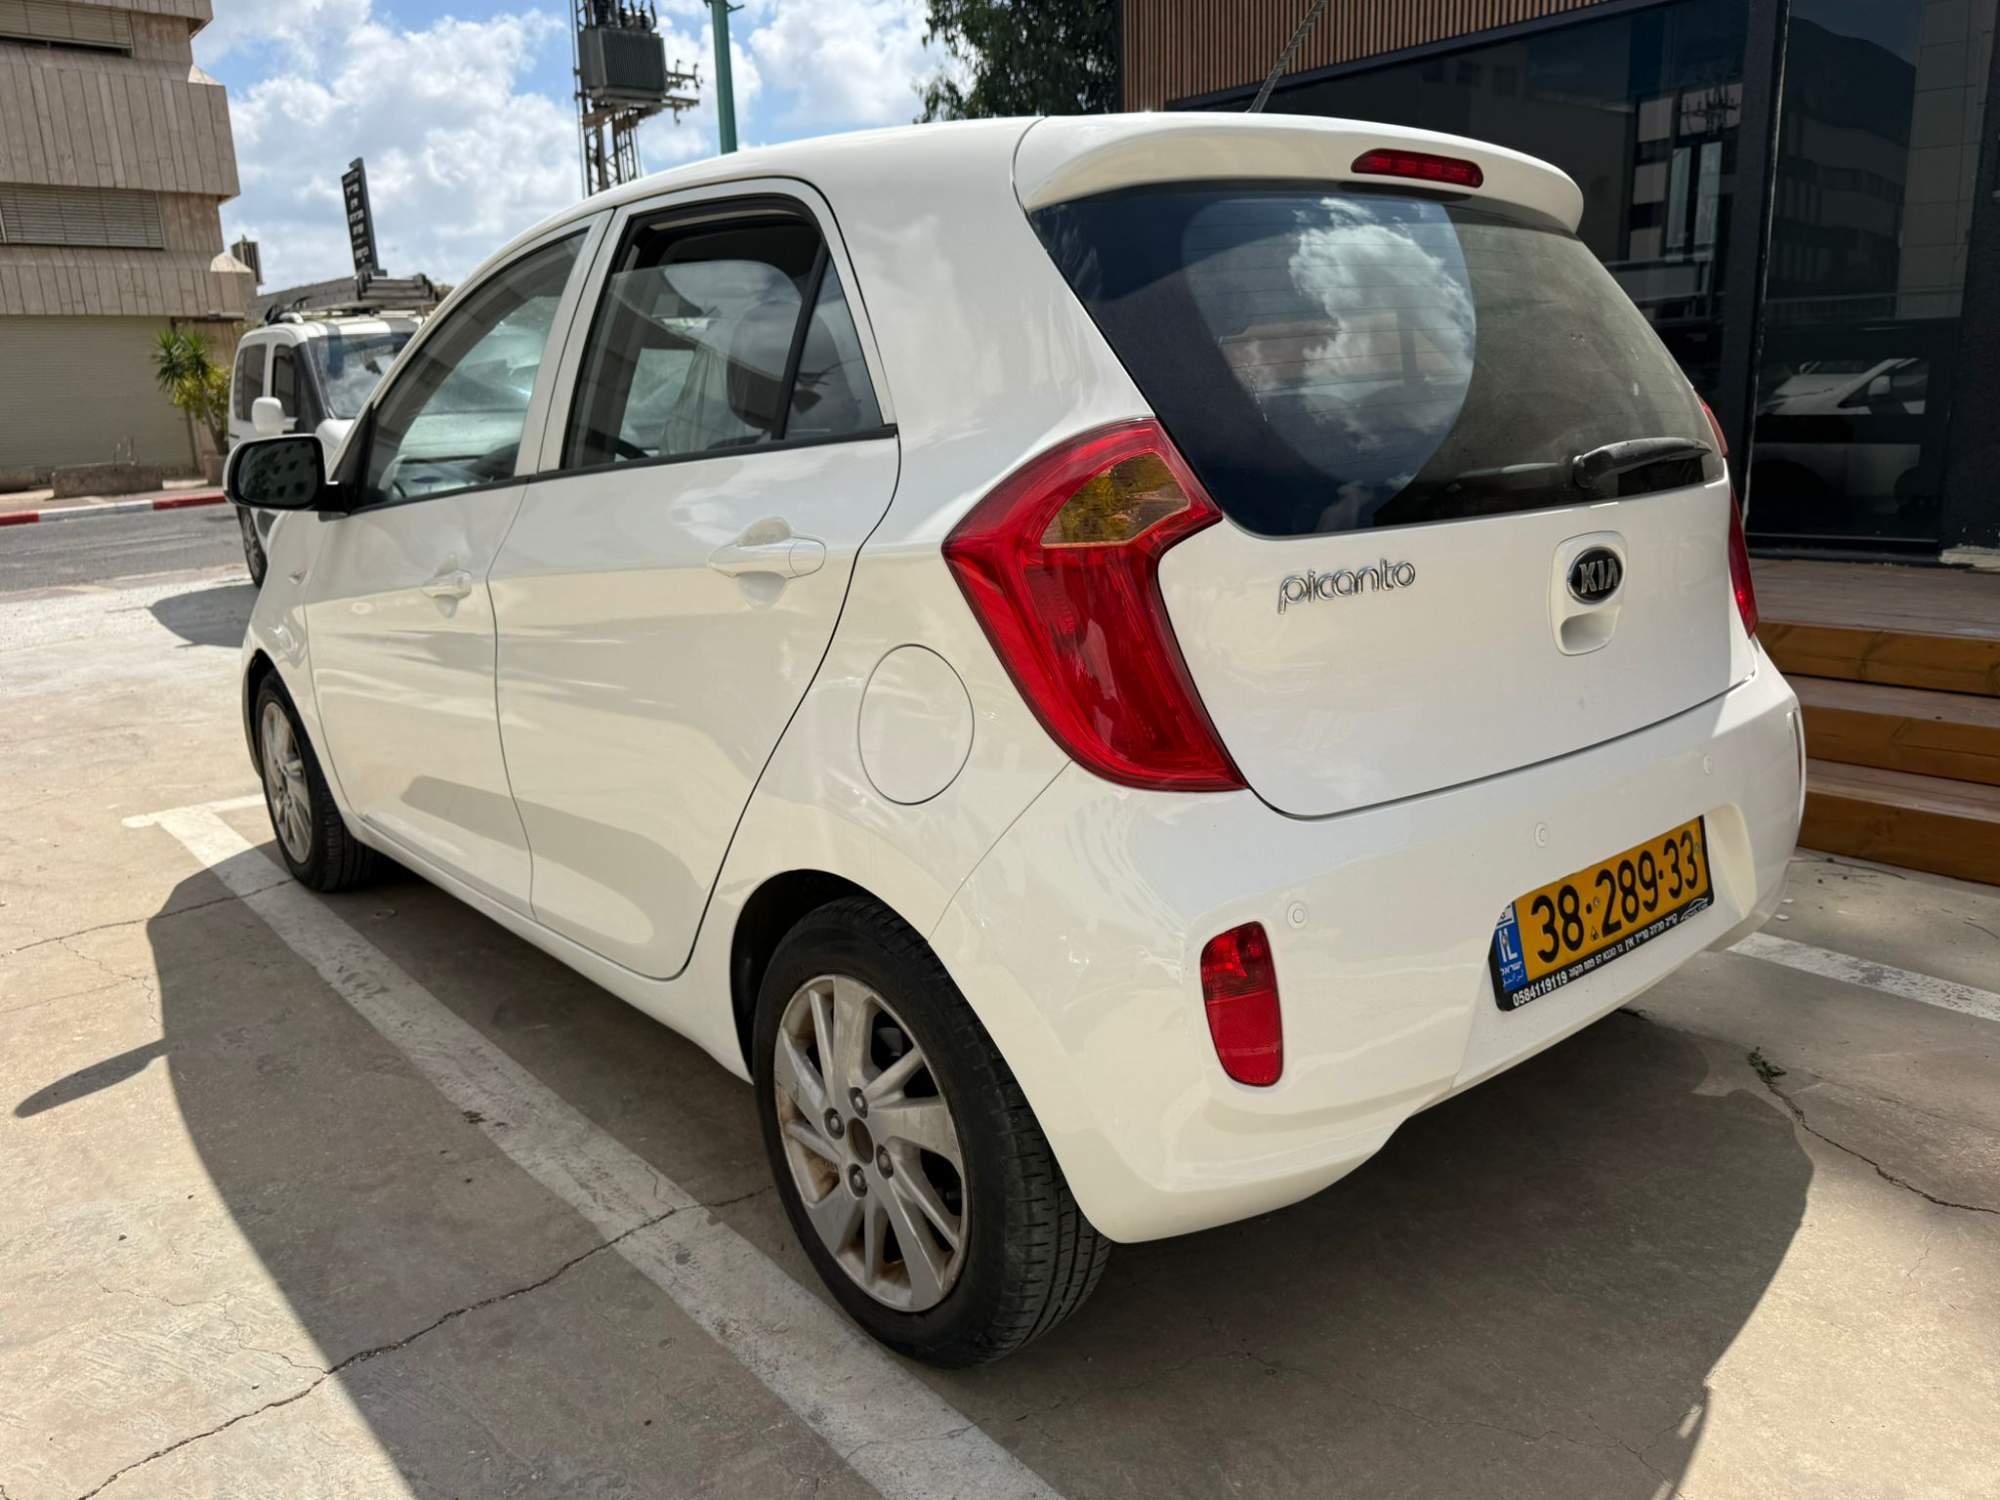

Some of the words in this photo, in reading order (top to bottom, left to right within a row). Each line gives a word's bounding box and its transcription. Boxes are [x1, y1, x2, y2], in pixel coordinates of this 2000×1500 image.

[1278, 558, 1416, 615] picanto
[1579, 559, 1619, 594] KIA
[1499, 927, 1518, 963] IL
[1512, 971, 1568, 1007] 0584119119
